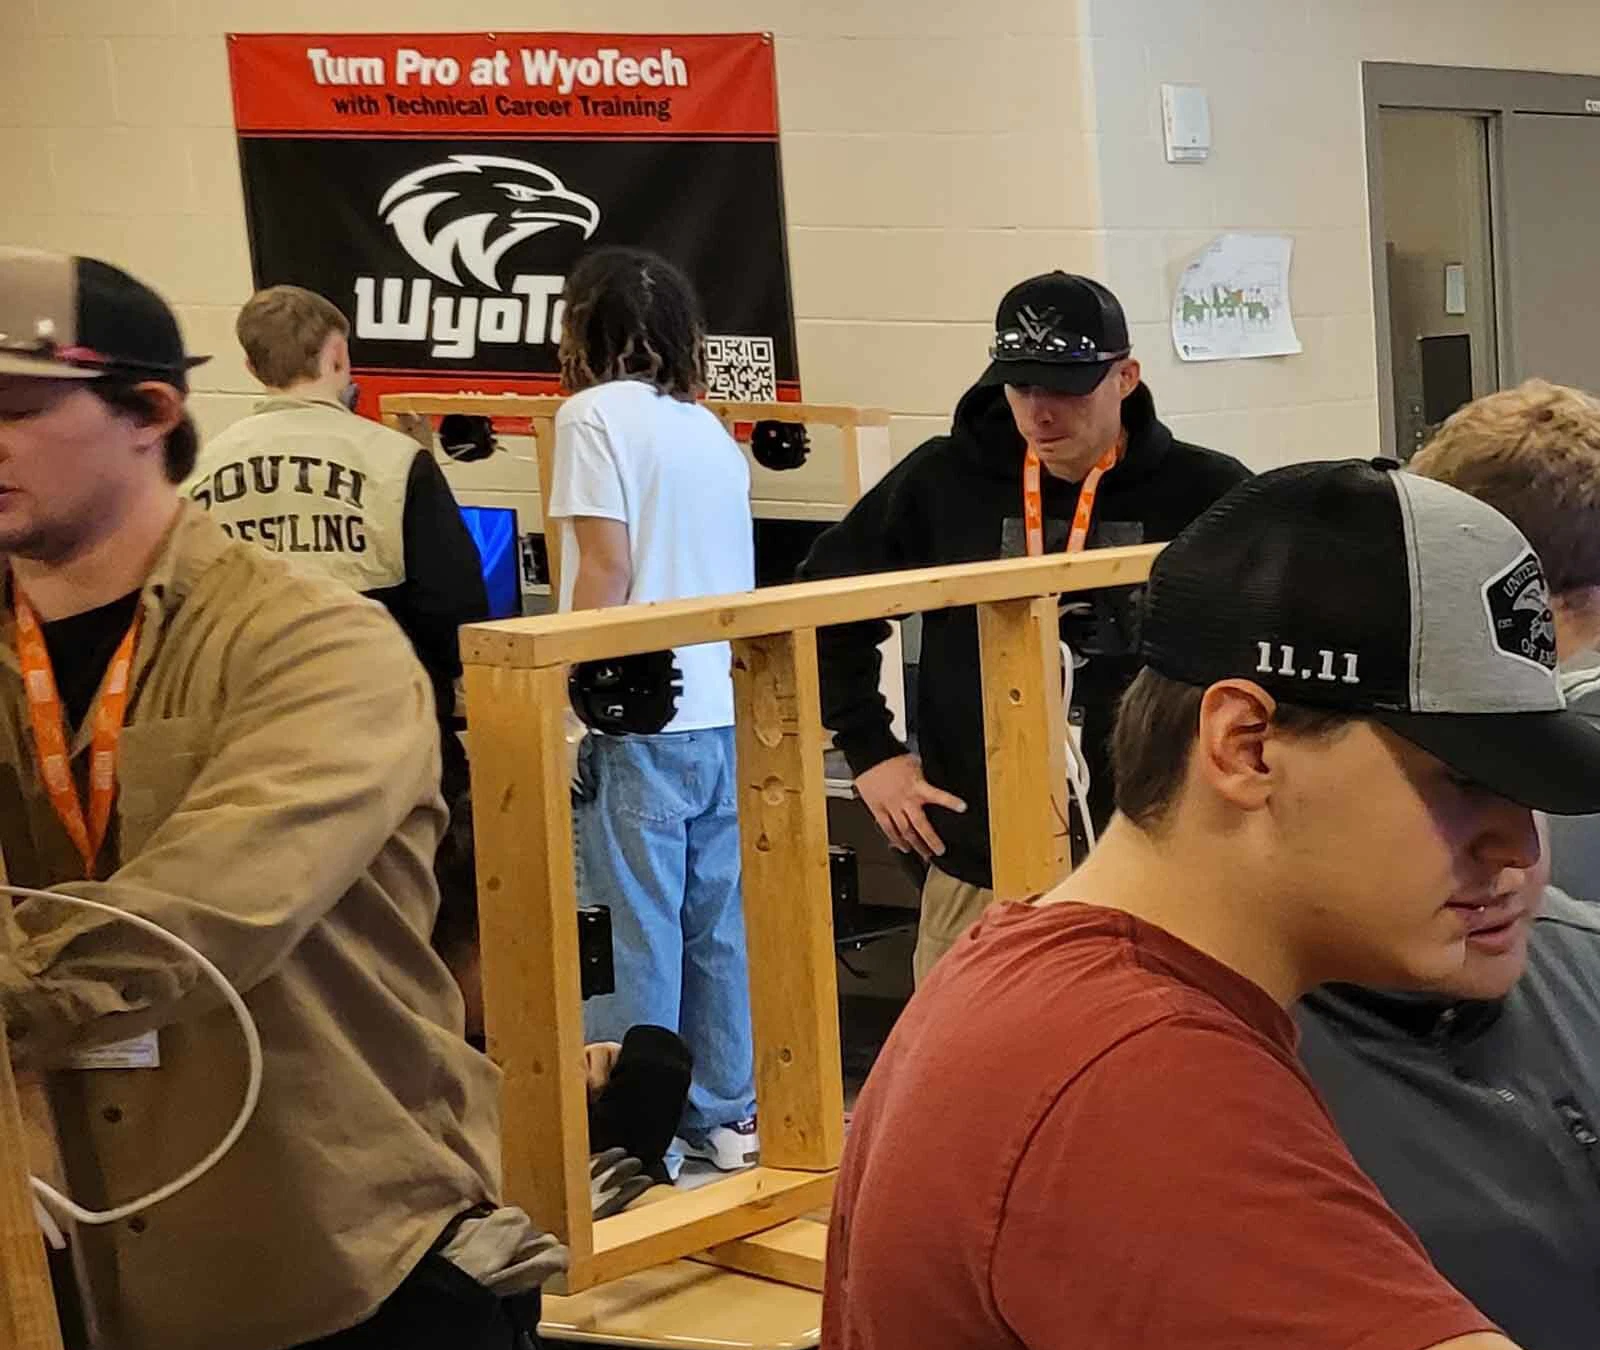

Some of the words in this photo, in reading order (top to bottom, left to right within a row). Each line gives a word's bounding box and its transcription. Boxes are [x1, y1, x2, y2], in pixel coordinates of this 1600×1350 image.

[308, 48, 384, 86] Turn
[396, 49, 460, 86] Pro
[470, 50, 511, 86] at
[522, 47, 688, 92] WyoTech
[335, 96, 380, 116] with
[388, 96, 488, 117] Technical
[495, 96, 572, 118] Career
[581, 97, 672, 122] Training
[190, 455, 367, 511] SOUTH
